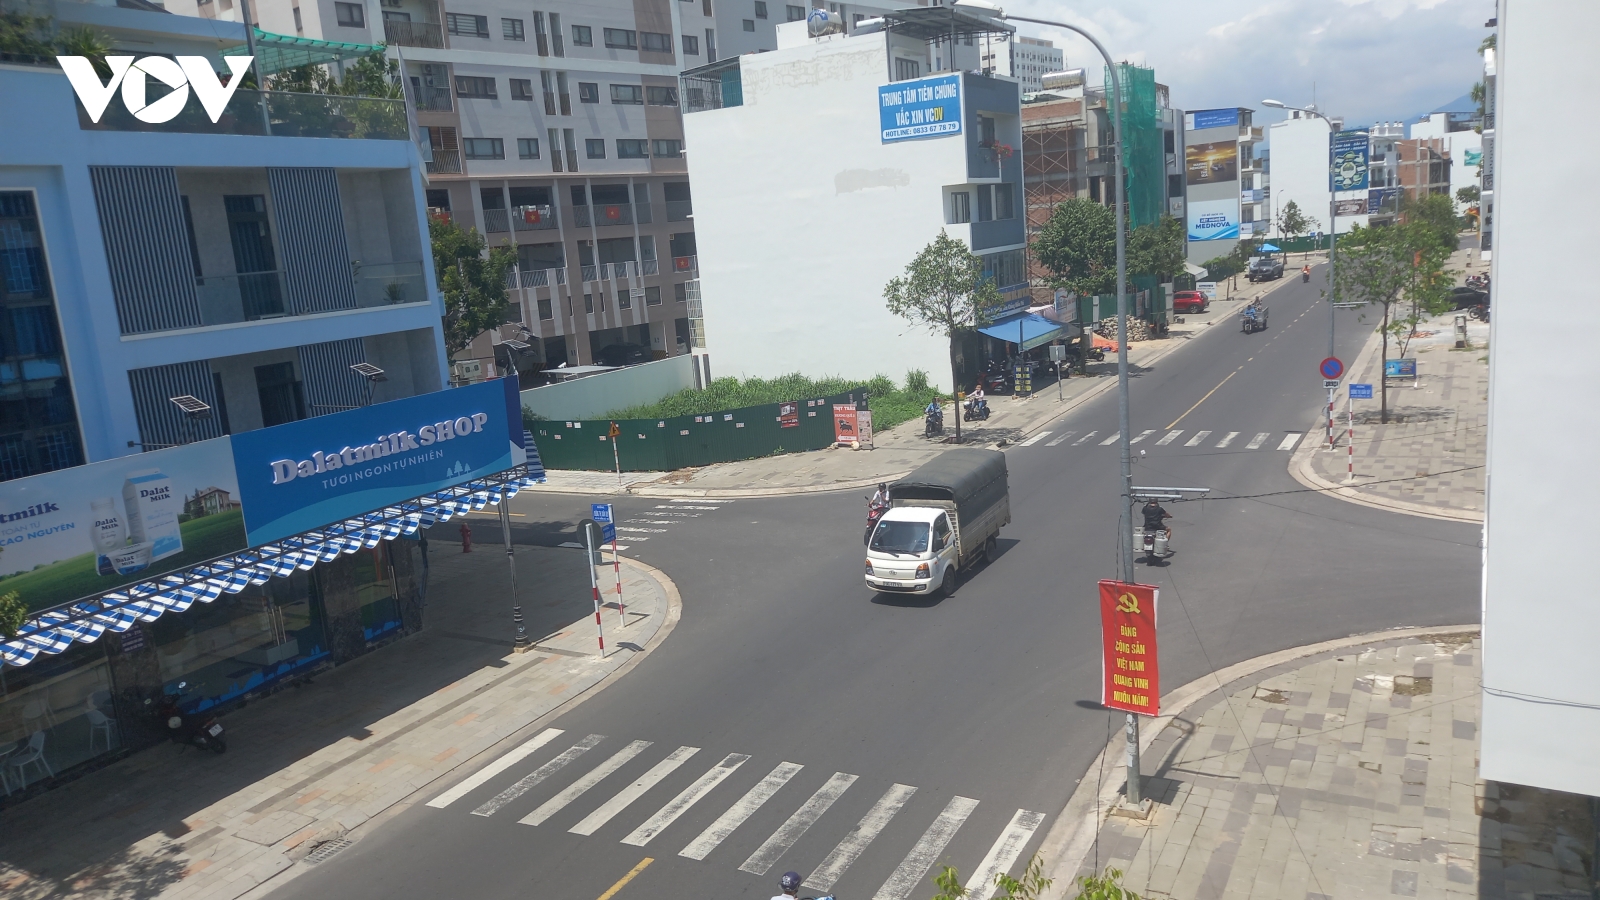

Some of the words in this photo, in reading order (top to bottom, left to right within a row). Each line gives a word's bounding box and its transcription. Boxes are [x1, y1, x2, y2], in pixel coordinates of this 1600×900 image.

[881, 91, 902, 107] TRUNG
[903, 87, 917, 104] TÂM
[917, 84, 933, 102] TIÊM
[934, 80, 957, 99] CHỦNG
[895, 107, 910, 126] VẮC
[911, 109, 924, 125] XIN
[885, 129, 912, 138] HOTLINE:
[939, 123, 946, 131] 78
[1195, 221, 1231, 230] MEDNOVA
[270, 430, 419, 485] Dalatmilk
[419, 412, 488, 446] SHOP
[140, 486, 170, 498] Dalat
[150, 493, 171, 502] Milk
[95, 517, 118, 527] Dalat
[27, 522, 75, 540] NGUYÊN
[1120, 623, 1137, 637] ĐẢNG
[1131, 641, 1146, 655] SẢN
[1116, 657, 1128, 671] VIỆT
[1129, 661, 1145, 672] NAM
[1113, 674, 1132, 688] QUANG
[1133, 677, 1149, 690] VINH
[1113, 690, 1131, 705] MUÔN
[1131, 693, 1149, 707] NĂM!
